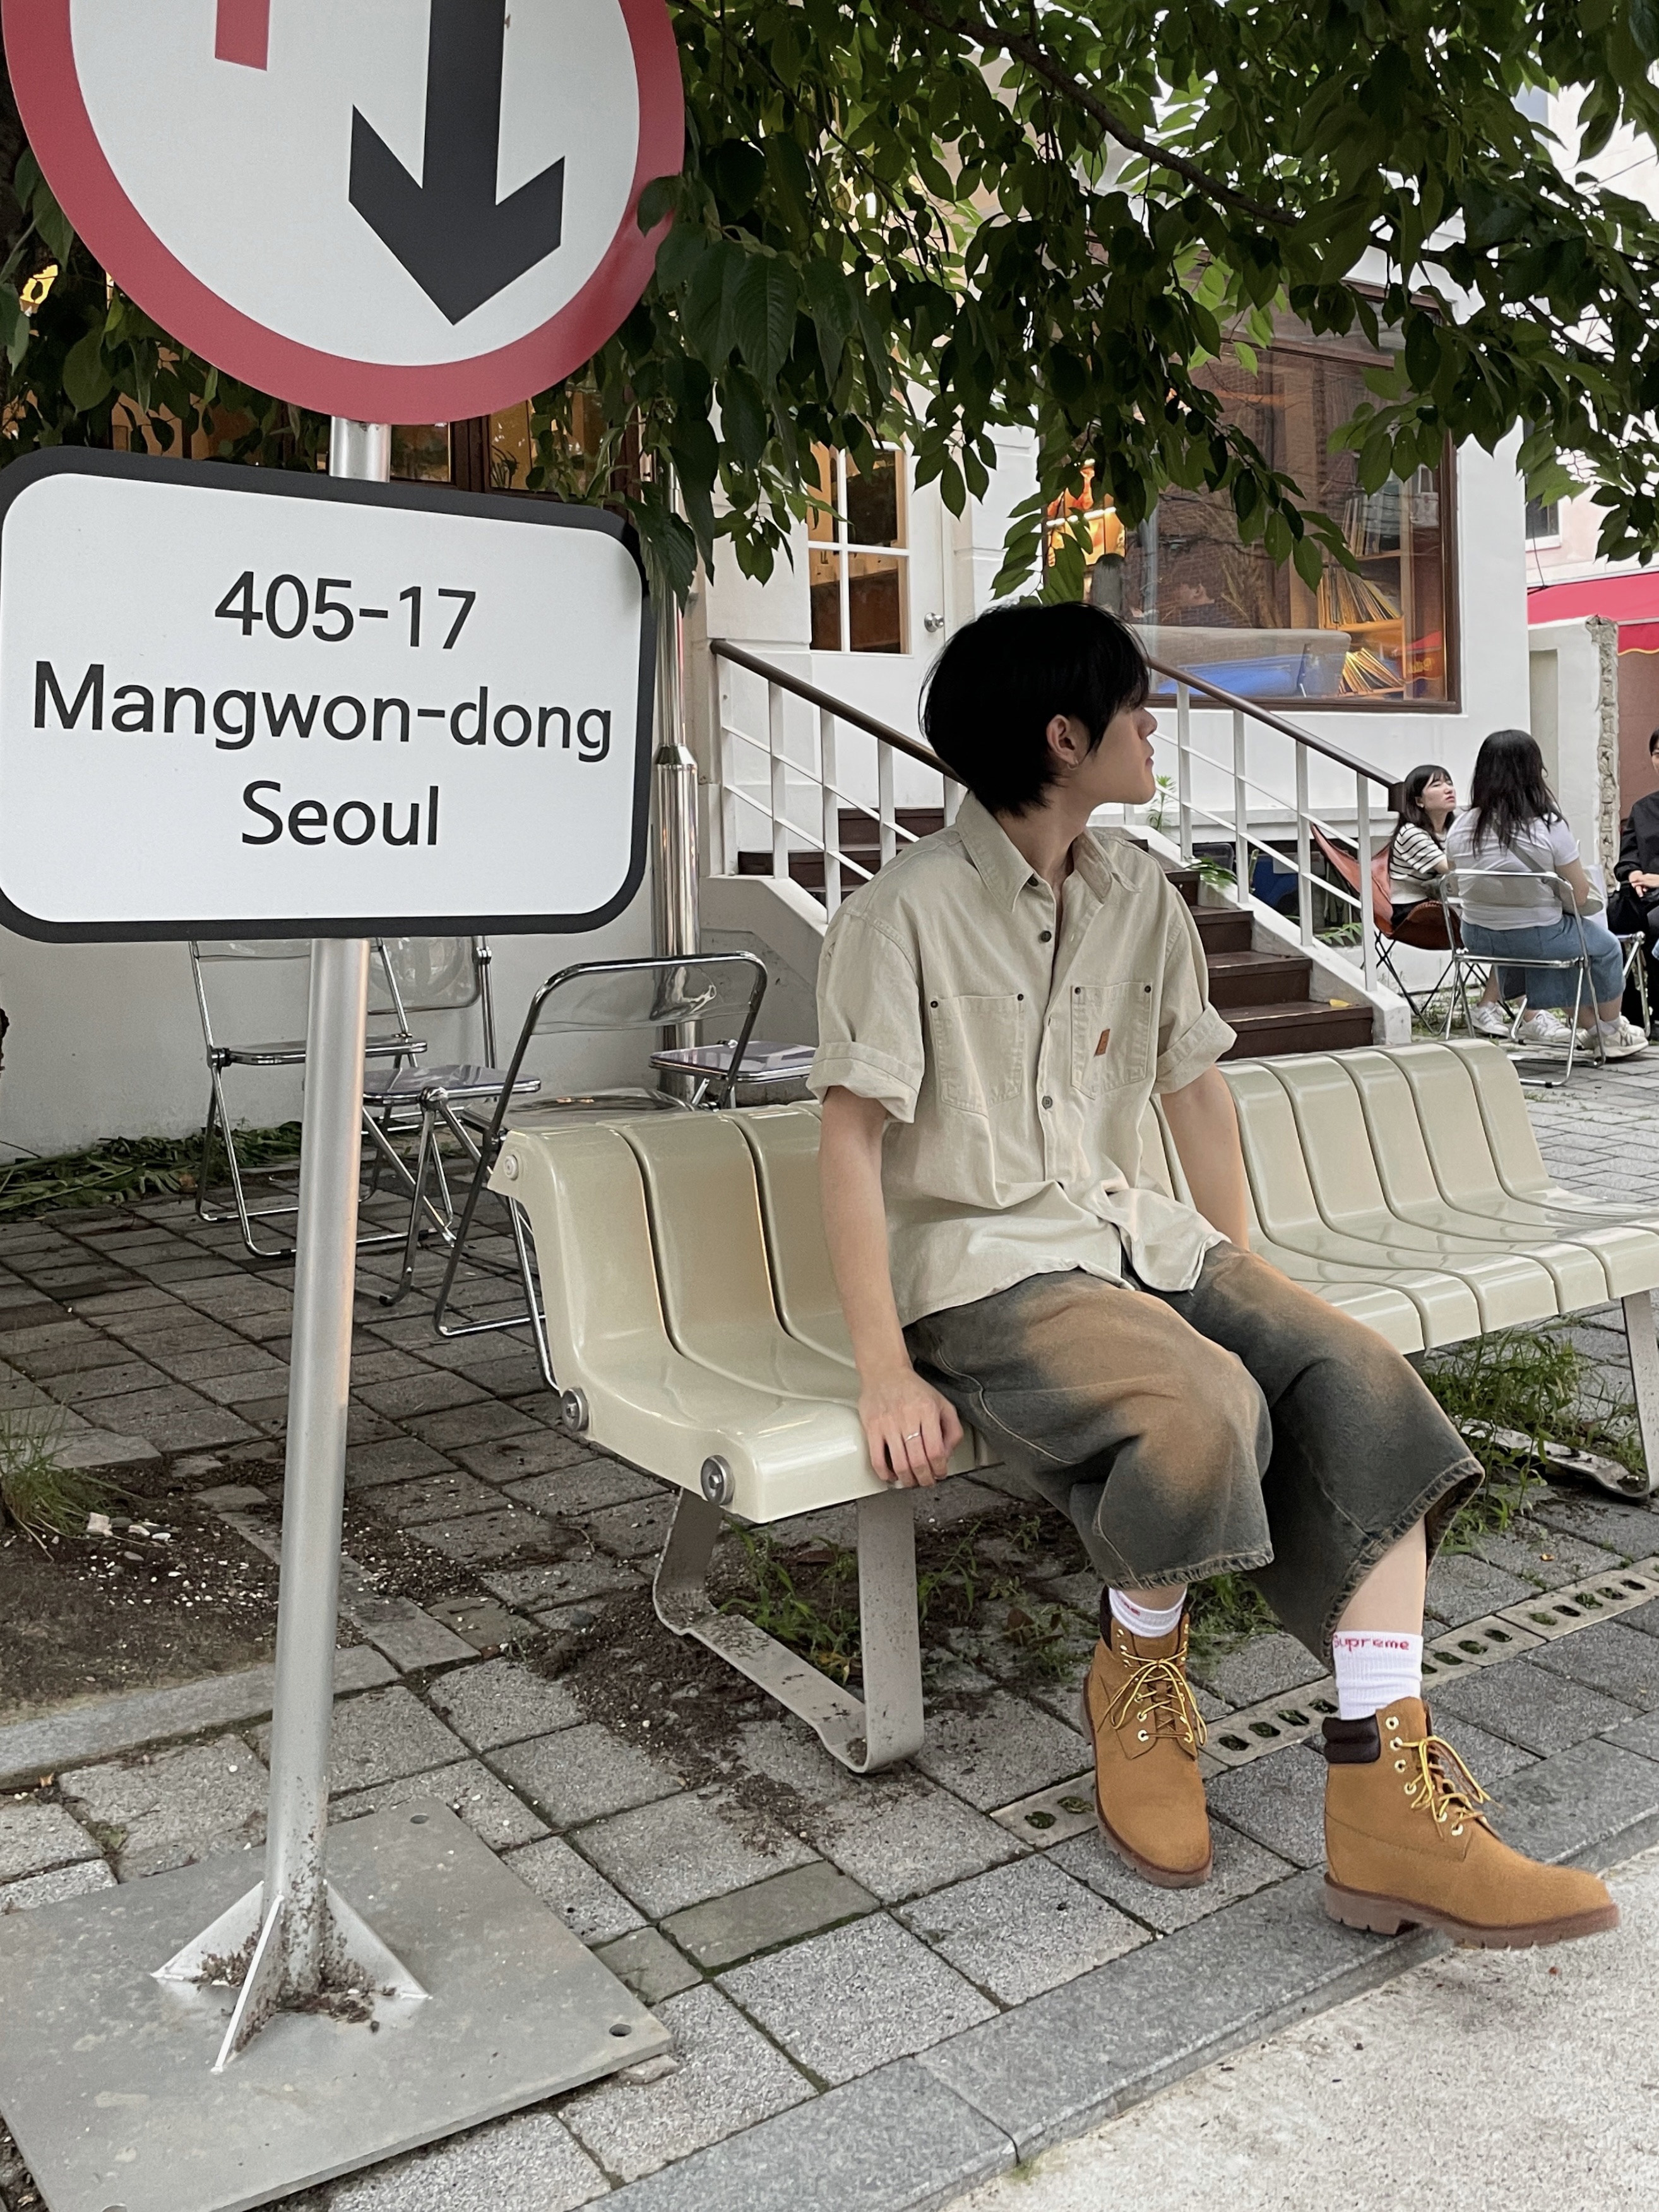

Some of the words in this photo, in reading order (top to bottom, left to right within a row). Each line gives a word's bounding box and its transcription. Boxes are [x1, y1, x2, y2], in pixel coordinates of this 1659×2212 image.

[214, 570, 477, 650] 405-17
[33, 660, 612, 763] Mangwon-dong
[241, 780, 439, 847] Seoul
[1333, 1634, 1410, 1651] Supreme
